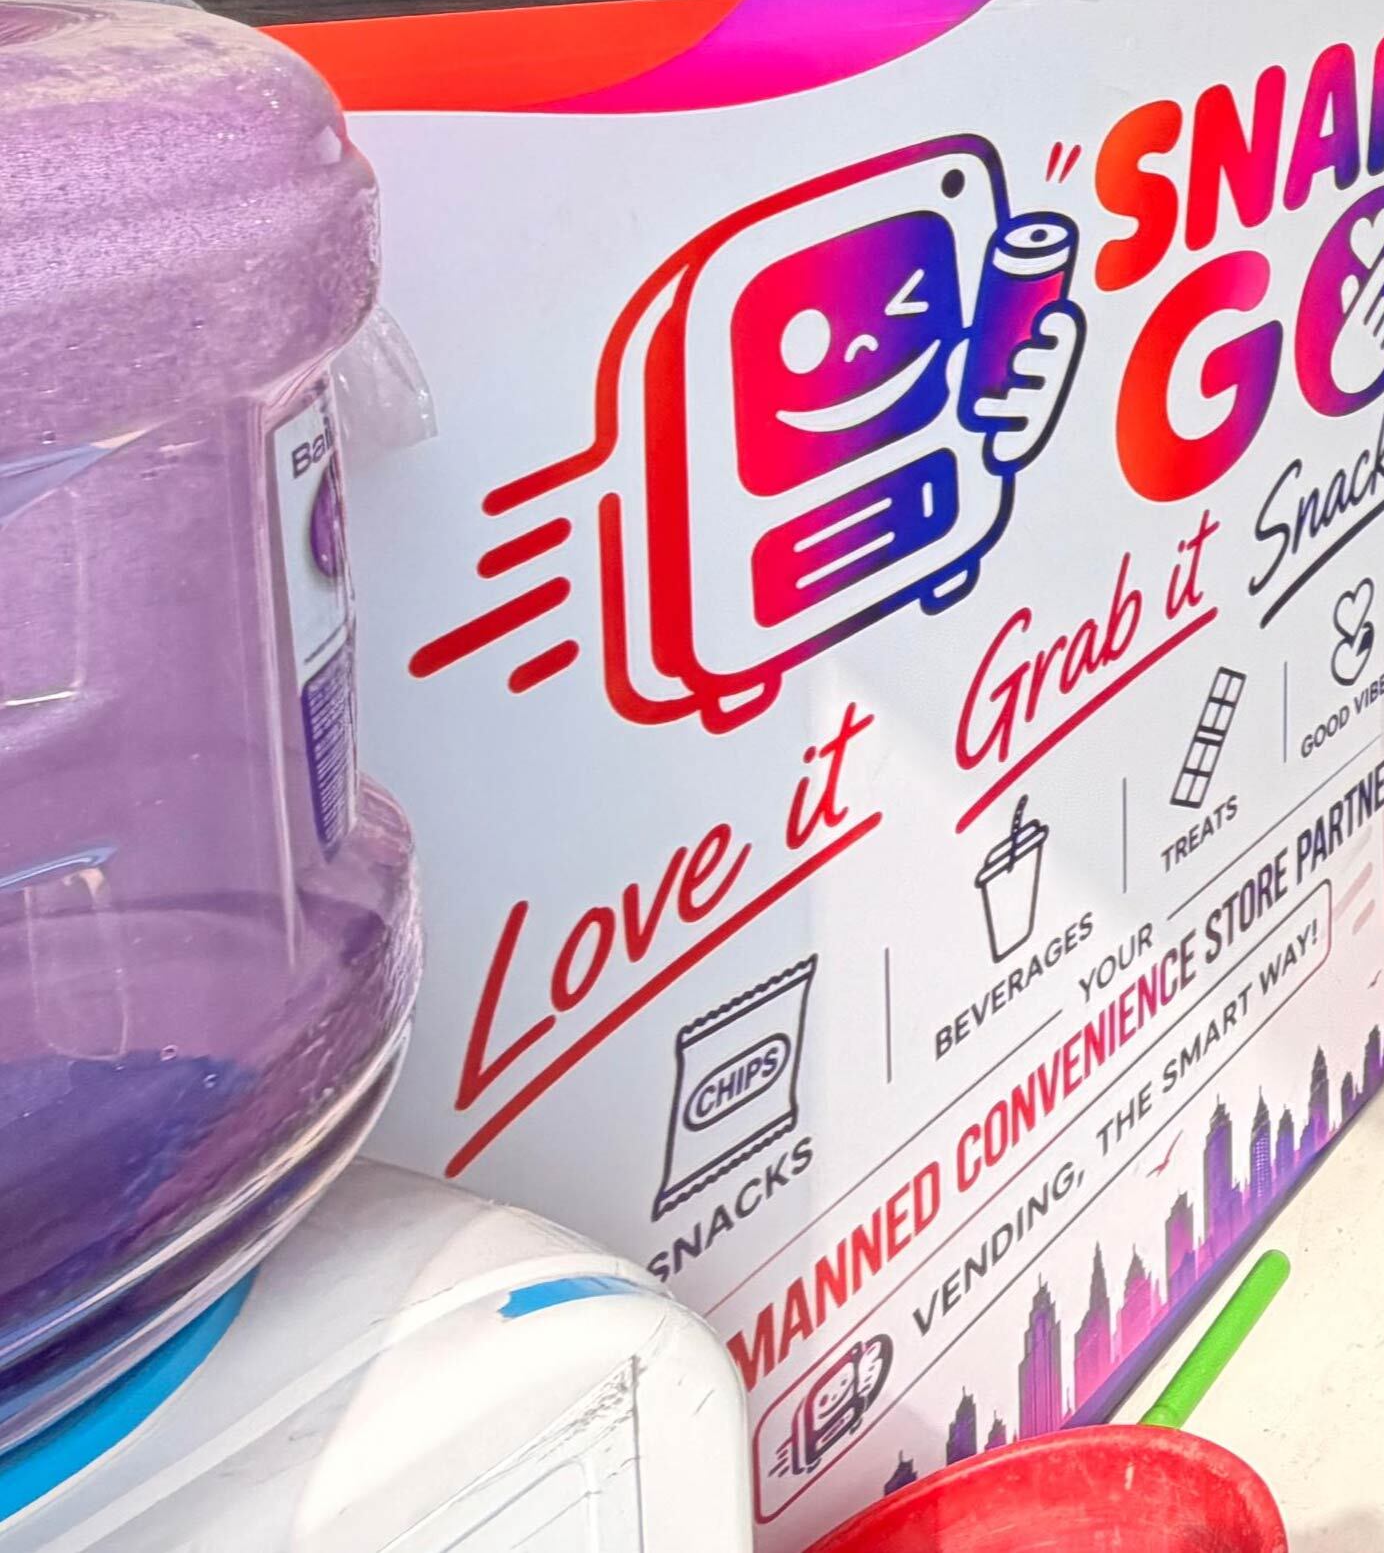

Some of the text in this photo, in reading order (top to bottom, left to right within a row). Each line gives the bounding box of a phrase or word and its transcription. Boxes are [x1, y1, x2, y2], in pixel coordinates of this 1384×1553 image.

[955, 508, 1221, 771] Grab it
[1300, 703, 1350, 758] GOOD
[455, 701, 875, 1112] Love it
[1160, 794, 1239, 874] TREATS
[933, 912, 1095, 1063] BEVERAGES
[955, 929, 1197, 1195] CONVENIENCE
[1204, 862, 1288, 965] STORE
[1077, 922, 1155, 1003] YOUR
[699, 1048, 780, 1117] CHIPS
[911, 919, 1320, 1338] VENDING, THE SMART WAY!
[646, 1136, 814, 1283] SNACKS
